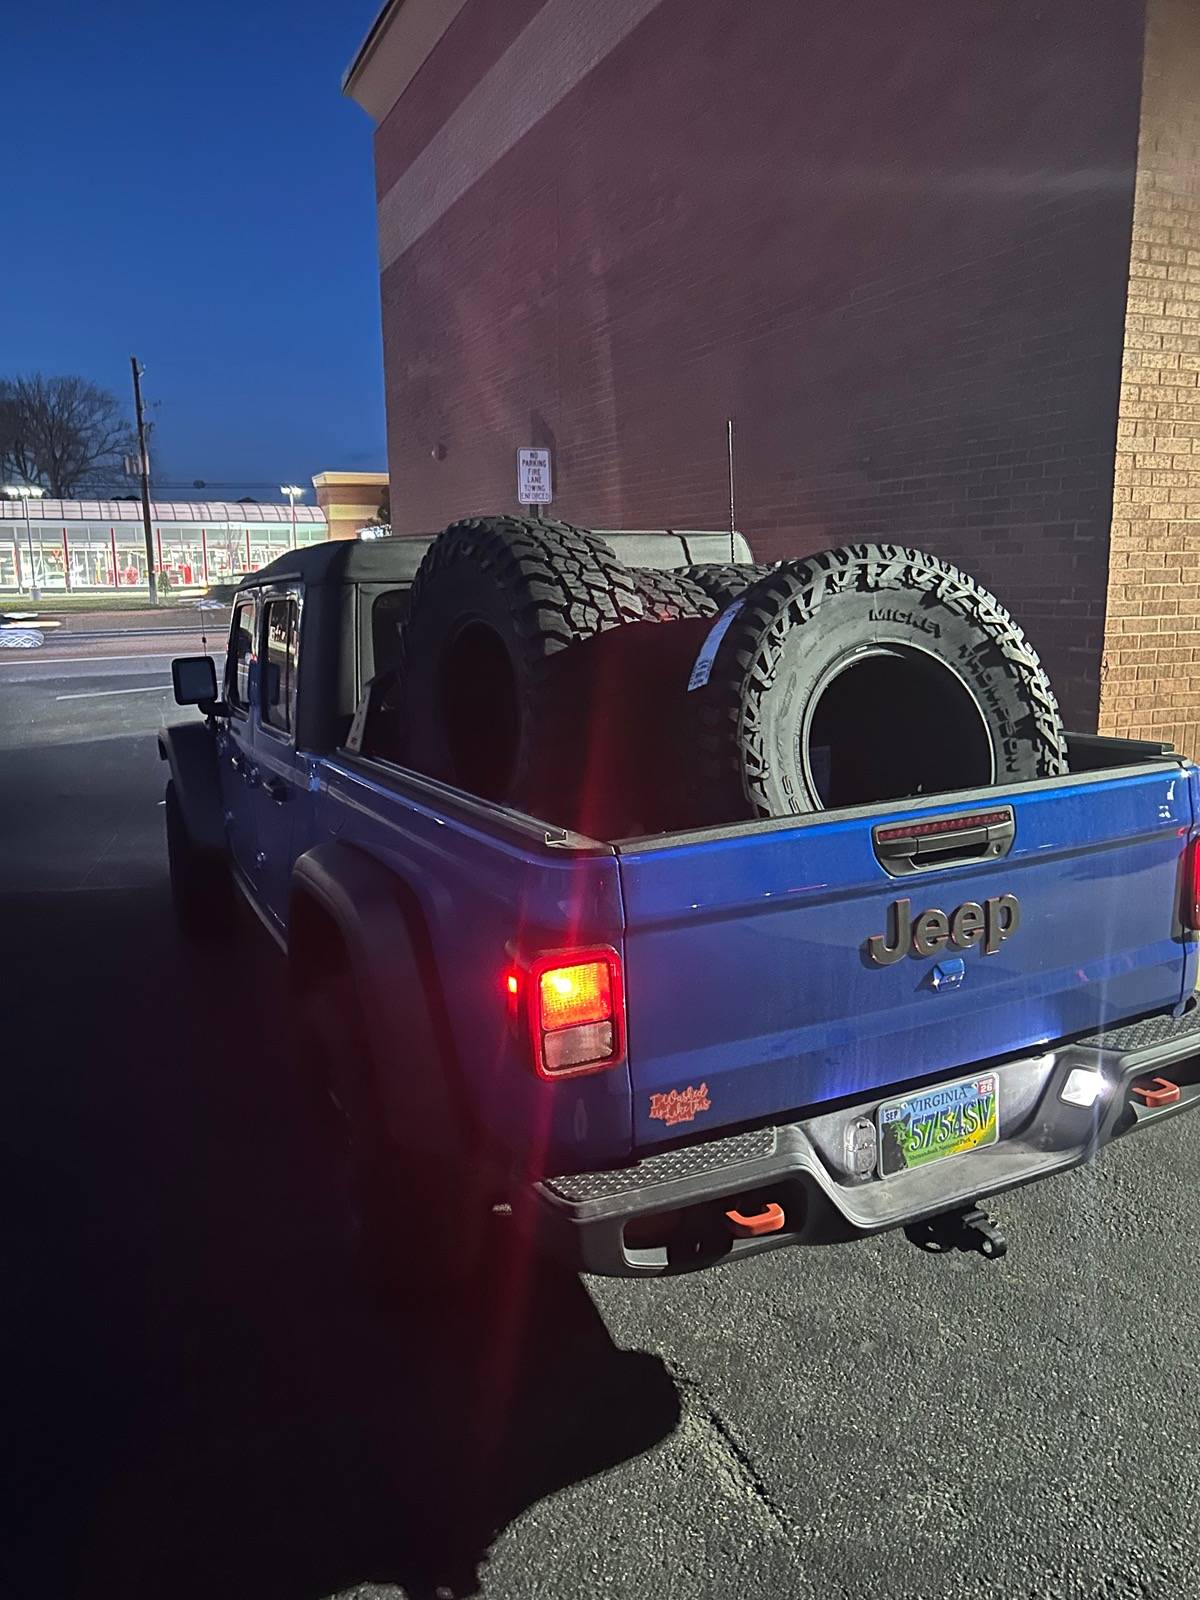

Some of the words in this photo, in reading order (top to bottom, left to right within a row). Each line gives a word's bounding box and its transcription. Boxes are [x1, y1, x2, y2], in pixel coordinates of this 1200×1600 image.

[521, 459, 547, 468] PARKING
[527, 468, 541, 476] FIRE
[527, 476, 542, 484] LANE
[524, 484, 546, 492] TOWING
[521, 492, 549, 500] ENFORCED
[957, 643, 1022, 773] THOMPSON
[867, 893, 1020, 966] Jeep
[980, 1085, 993, 1094] 26
[909, 1087, 968, 1113] VIRGINIA
[884, 1110, 898, 1122] SEP
[909, 1094, 994, 1150] 5754SV
